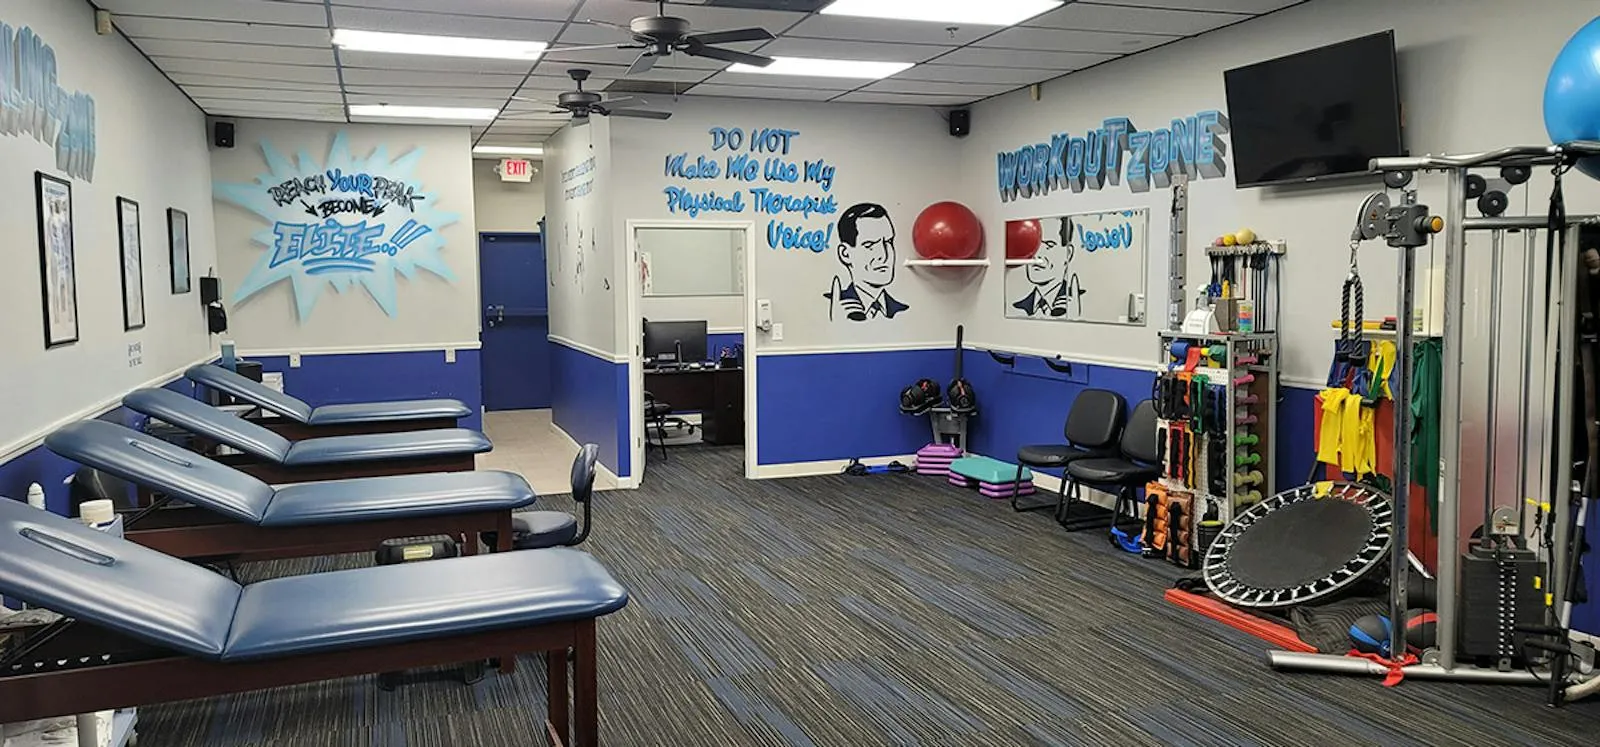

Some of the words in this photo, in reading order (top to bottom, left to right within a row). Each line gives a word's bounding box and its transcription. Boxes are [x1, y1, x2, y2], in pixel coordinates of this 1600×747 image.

[708, 126, 745, 151] DO
[750, 127, 801, 155] NOT
[996, 116, 1135, 203] WORKOUT
[1126, 109, 1230, 193] ZONE
[505, 160, 528, 176] EXIT
[664, 152, 721, 180] Make
[725, 153, 760, 182] Me
[764, 158, 799, 182] Use
[803, 158, 836, 192] My
[267, 174, 327, 207] REACH
[326, 168, 374, 198] YOUR
[373, 176, 426, 213] PEAK
[317, 196, 375, 219] BECOME
[663, 185, 746, 219] Physical
[749, 187, 838, 220] Therapist
[767, 219, 835, 254] Voice!
